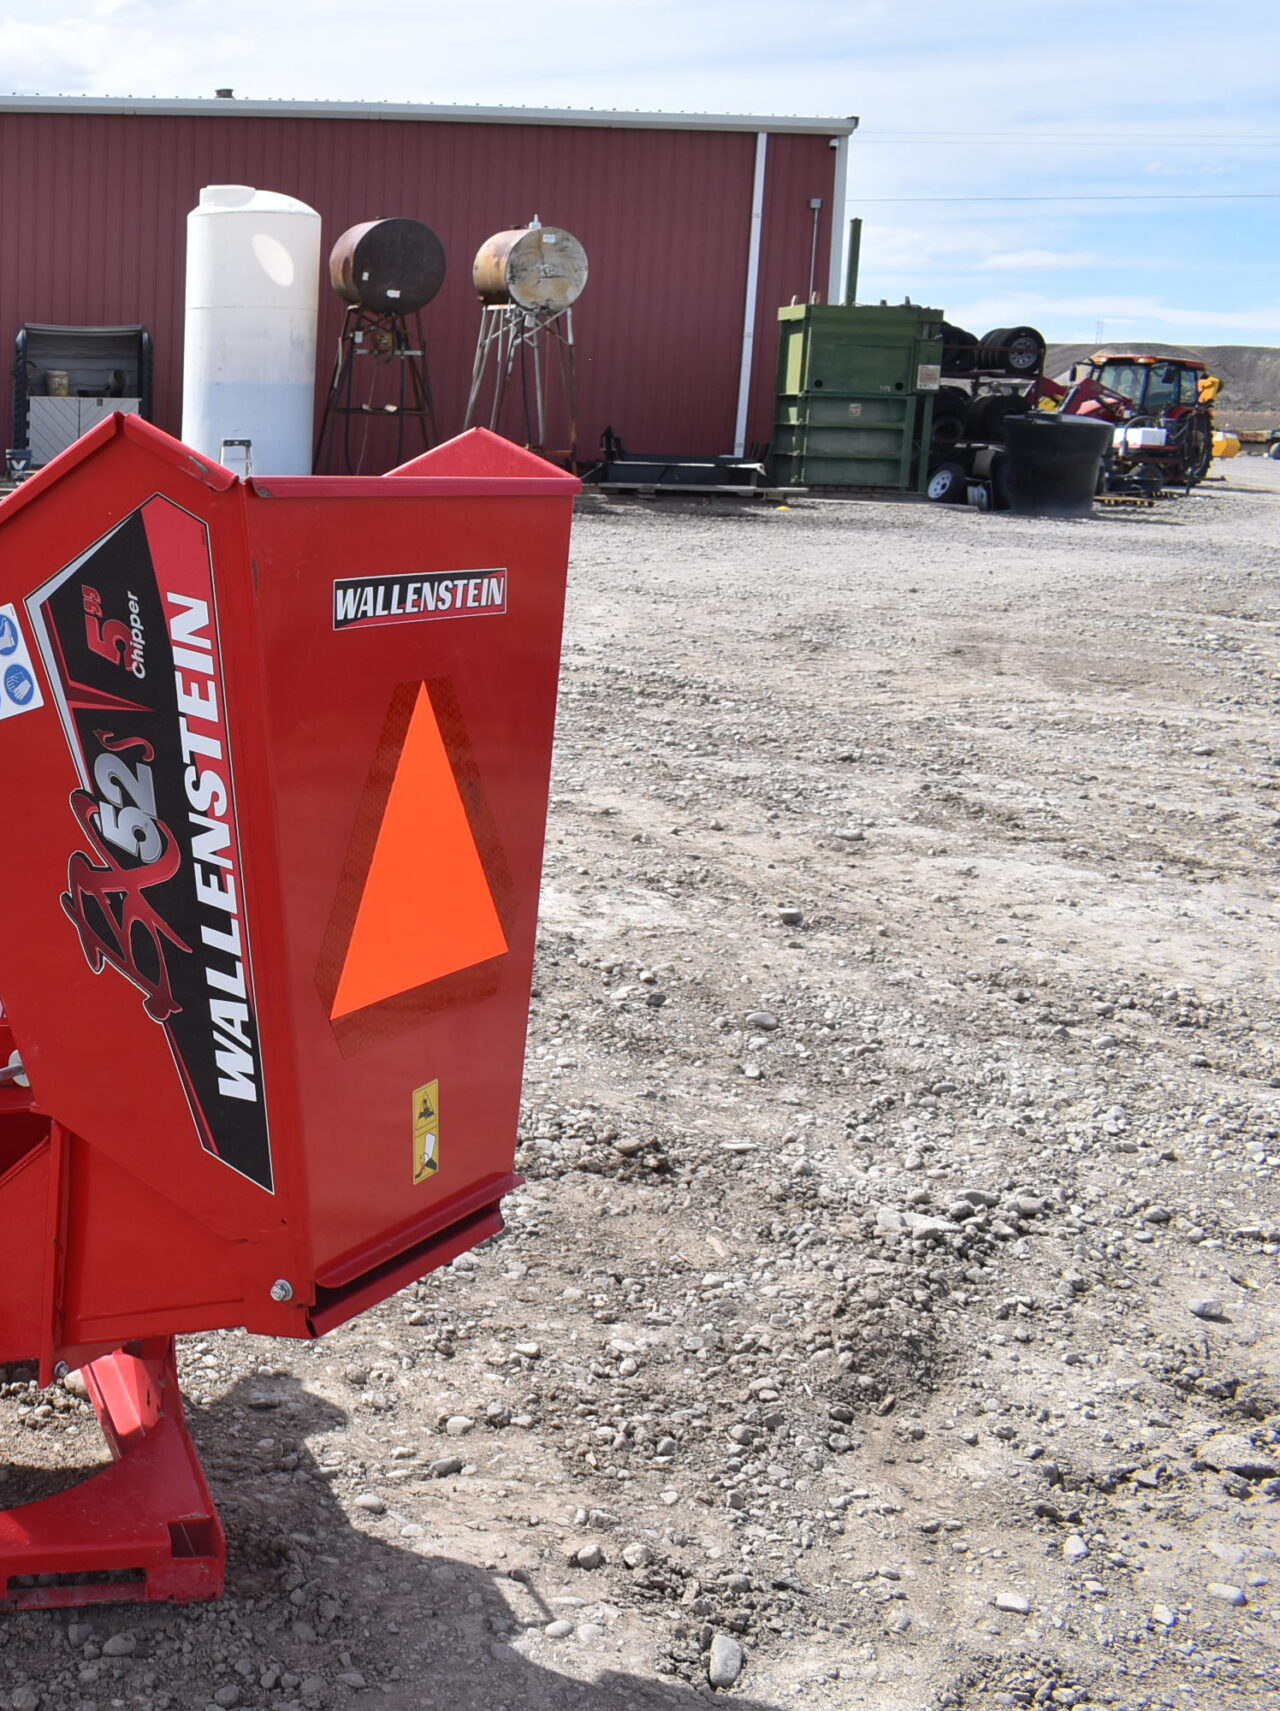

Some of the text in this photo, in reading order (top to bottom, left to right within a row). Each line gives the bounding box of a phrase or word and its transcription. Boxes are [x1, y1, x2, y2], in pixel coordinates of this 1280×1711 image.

[127, 590, 146, 679] Chipper
[336, 577, 504, 621] WALLENSTEIN
[167, 591, 258, 1103] WALLENSTEIN
